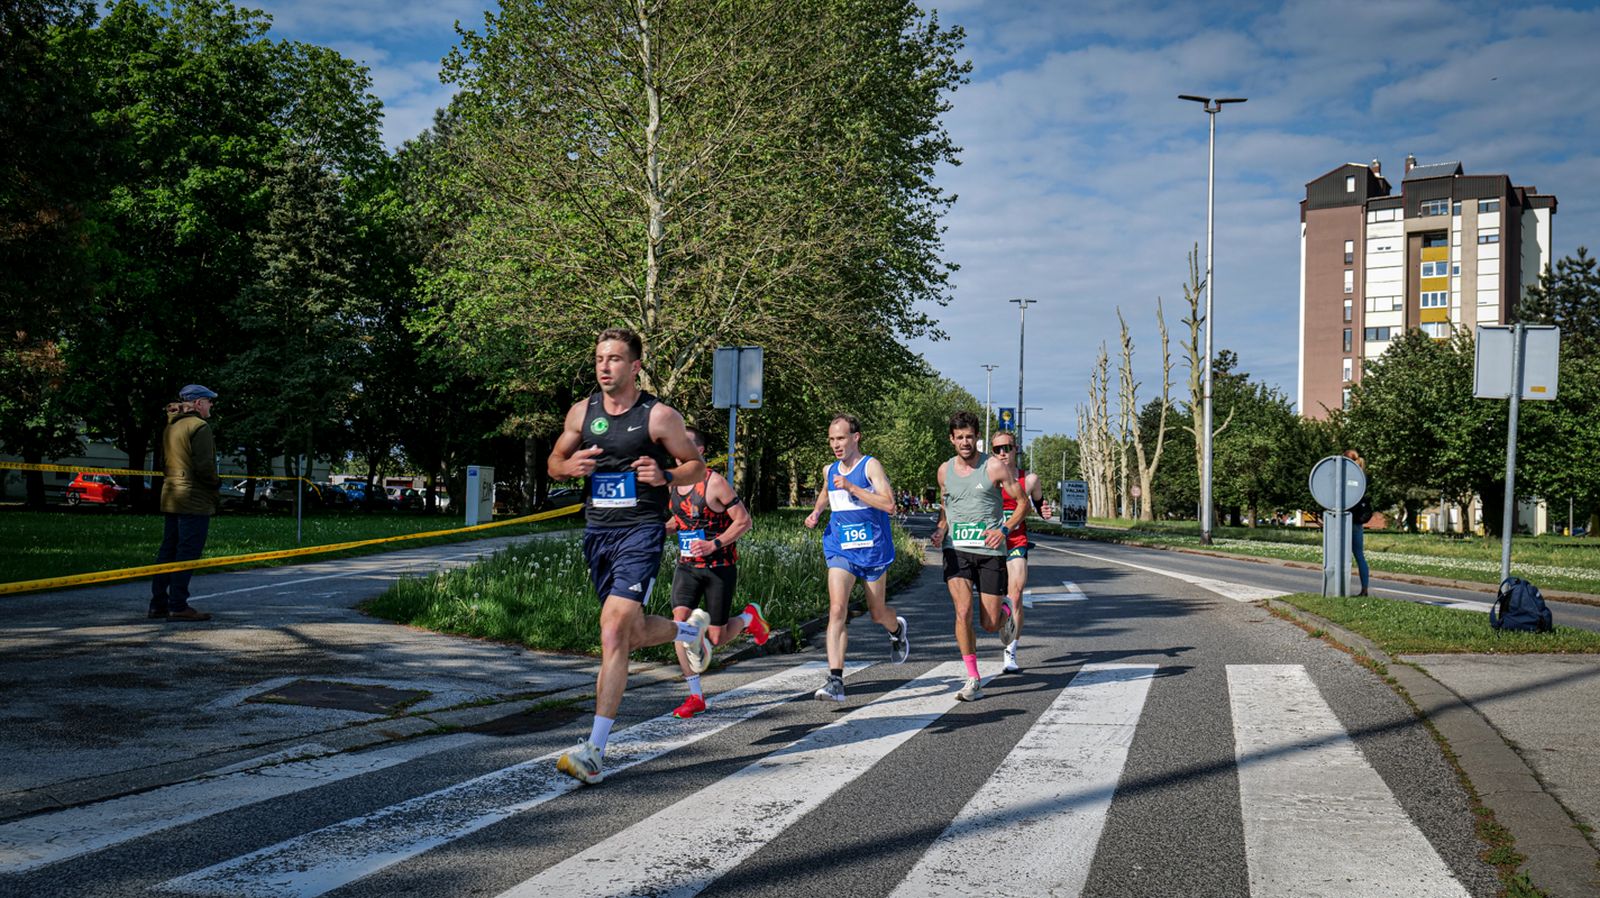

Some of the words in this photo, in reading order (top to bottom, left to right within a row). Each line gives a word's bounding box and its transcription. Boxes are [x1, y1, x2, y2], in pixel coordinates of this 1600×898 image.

[597, 482, 626, 498] 451
[844, 528, 867, 542] 196
[955, 528, 983, 539] 1077
[681, 537, 700, 550] 27
